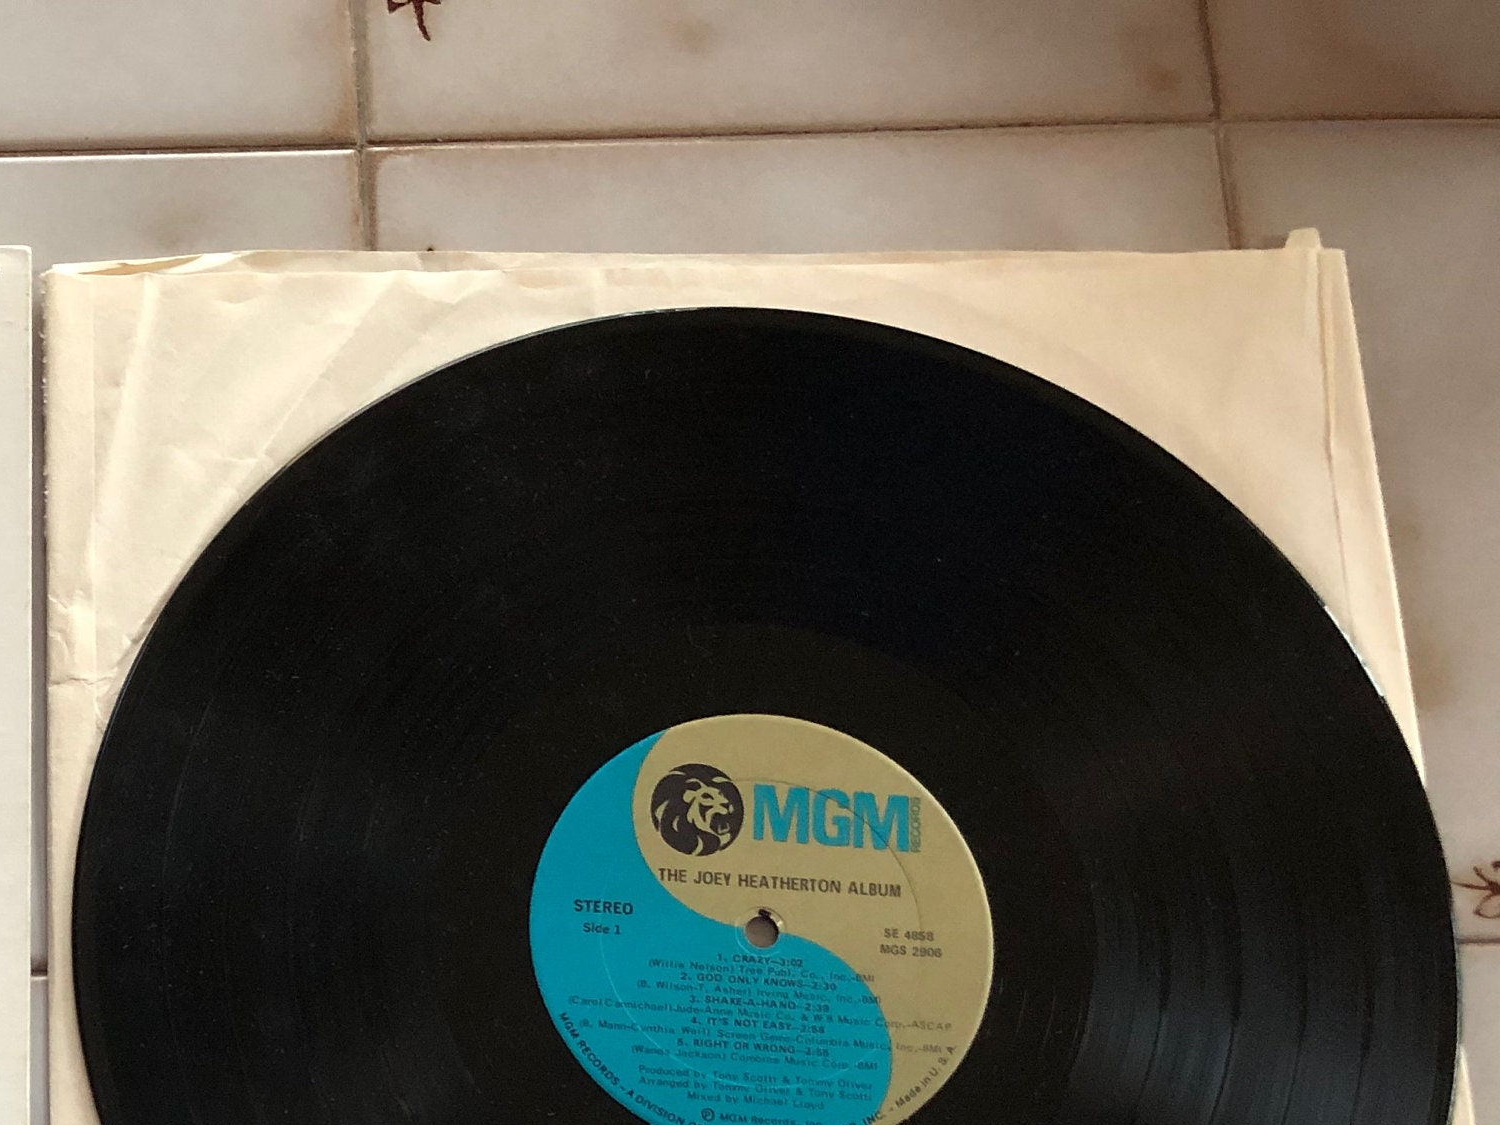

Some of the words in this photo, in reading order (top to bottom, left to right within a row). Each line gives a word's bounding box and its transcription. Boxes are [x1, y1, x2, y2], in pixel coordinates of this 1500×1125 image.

[753, 783, 910, 853] MGM
[659, 867, 688, 883] THE
[693, 871, 731, 886] JOEY
[738, 874, 841, 893] HEATHERTON
[848, 881, 901, 898] ALBUM
[574, 899, 634, 915] STEREO
[583, 922, 610, 934] Side
[615, 925, 621, 935] 1
[883, 928, 900, 939] SE
[904, 931, 934, 942] 4858
[879, 943, 907, 956] MGS
[696, 974, 723, 983] GOD
[728, 975, 759, 986] ONLY
[733, 1019, 758, 1029] NOT
[693, 1038, 729, 1050] RIGHT
[734, 1041, 751, 1051] OR
[559, 1012, 580, 1039] MGM
[577, 1039, 620, 1086] RECORDS
[635, 1095, 685, 1125] DIVISION
[895, 1086, 922, 1108] Made
[720, 1112, 747, 1123] MGM
